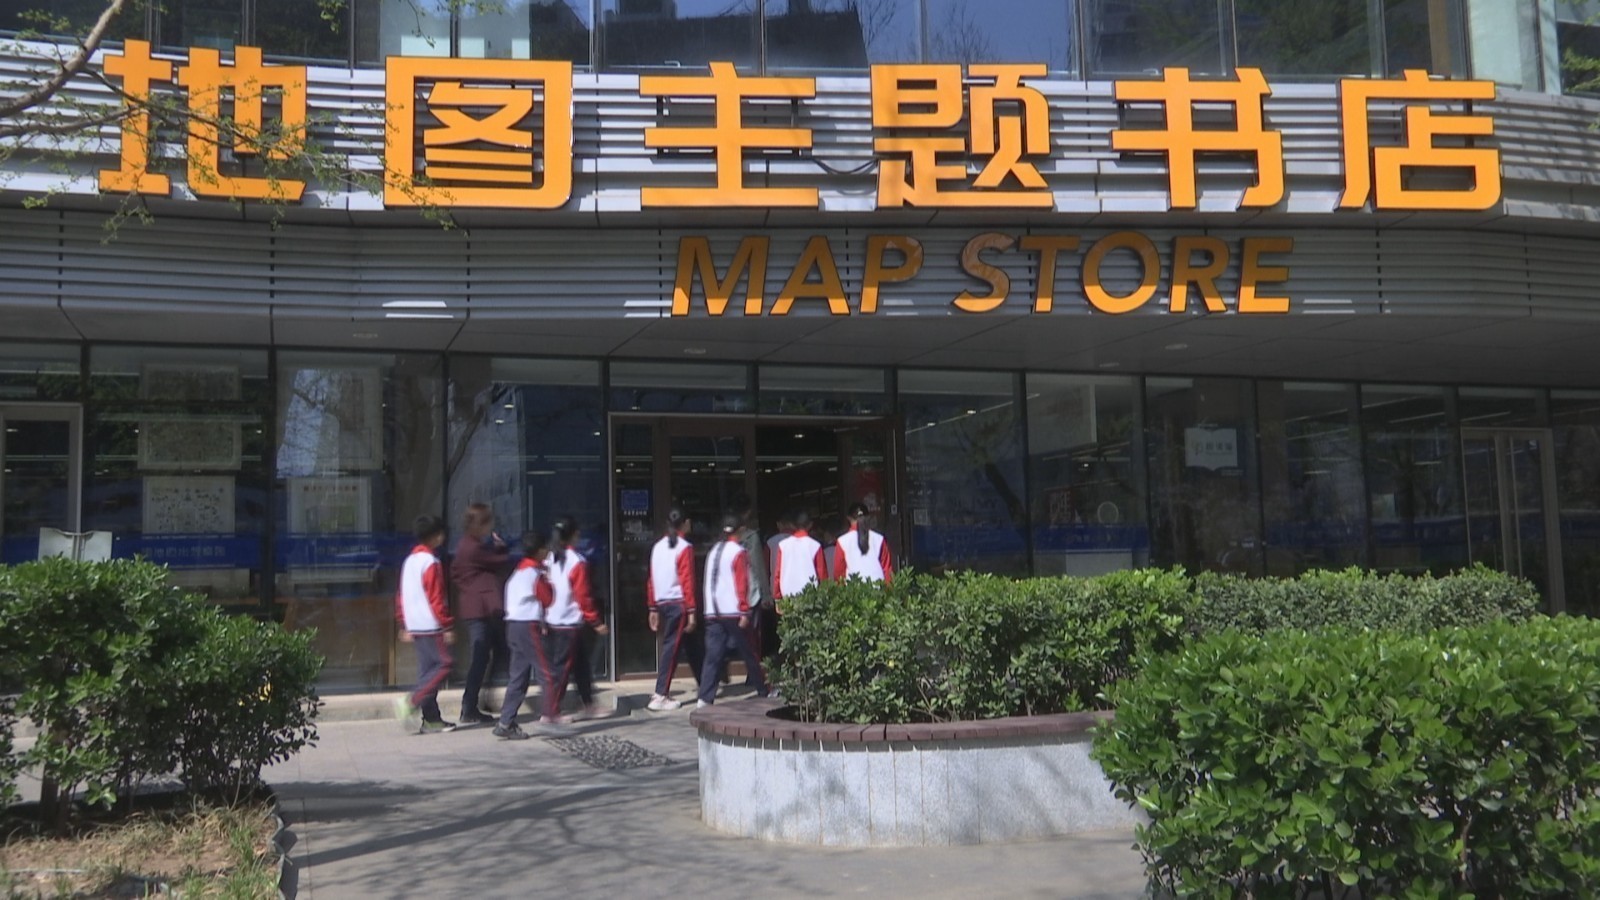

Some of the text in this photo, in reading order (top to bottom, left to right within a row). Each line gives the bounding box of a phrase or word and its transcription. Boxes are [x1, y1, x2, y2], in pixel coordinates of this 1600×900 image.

[98, 38, 1503, 211] 地图主题书店
[671, 231, 1294, 317] MAP STORE
